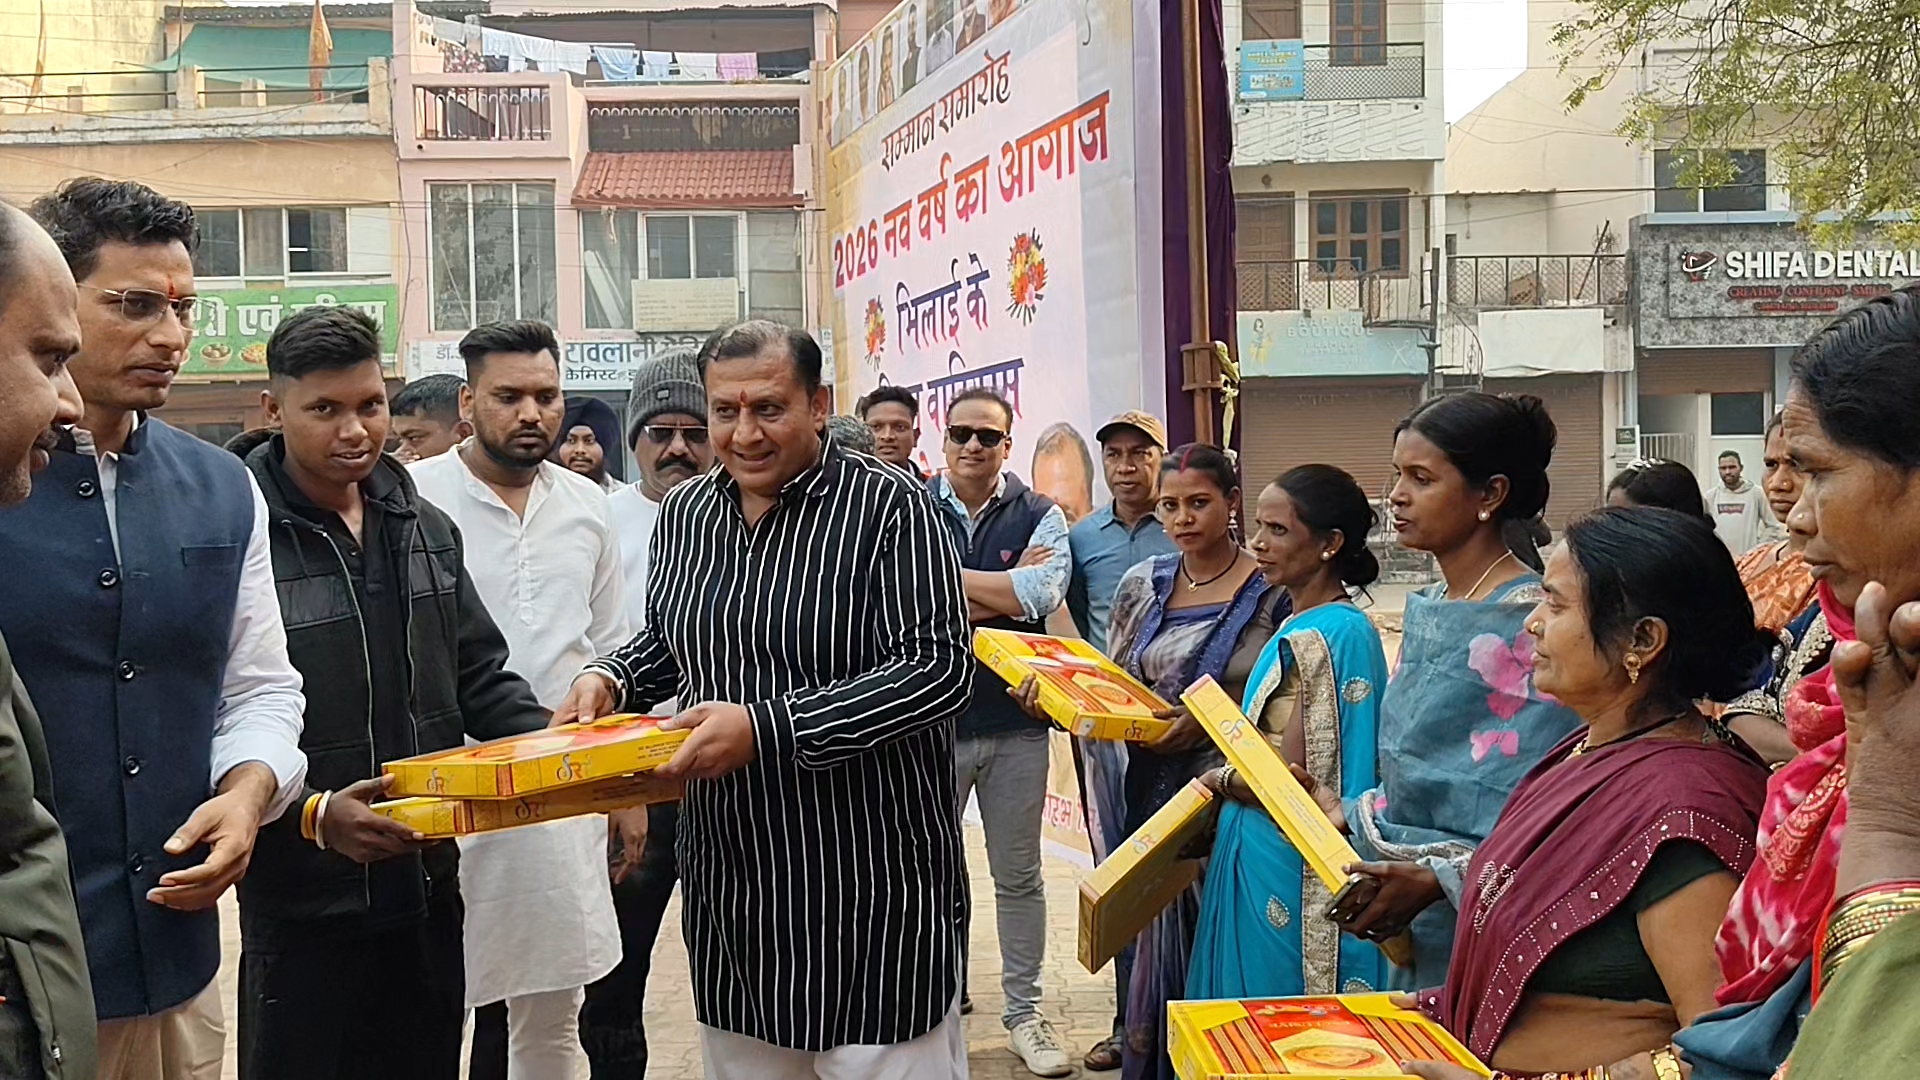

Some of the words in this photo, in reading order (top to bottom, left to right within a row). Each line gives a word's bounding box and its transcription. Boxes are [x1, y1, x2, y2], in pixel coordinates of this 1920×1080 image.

[882, 103, 936, 171] सम्मान
[938, 49, 1011, 134] समारोह
[834, 218, 879, 289] 2026
[883, 199, 913, 258] नव
[917, 151, 953, 242] वर्ष
[954, 154, 991, 223] का
[997, 89, 1111, 204] आगाज
[1725, 250, 1808, 279] SHIFA
[896, 257, 963, 356] भिलाई
[965, 252, 992, 332] के
[1729, 286, 1782, 298] CREATING
[1787, 286, 1846, 297] CONFIDENT
[236, 295, 284, 336] एवं
[1287, 326, 1375, 338] BOUTIQUE
[565, 366, 617, 381] केमिस्ट
